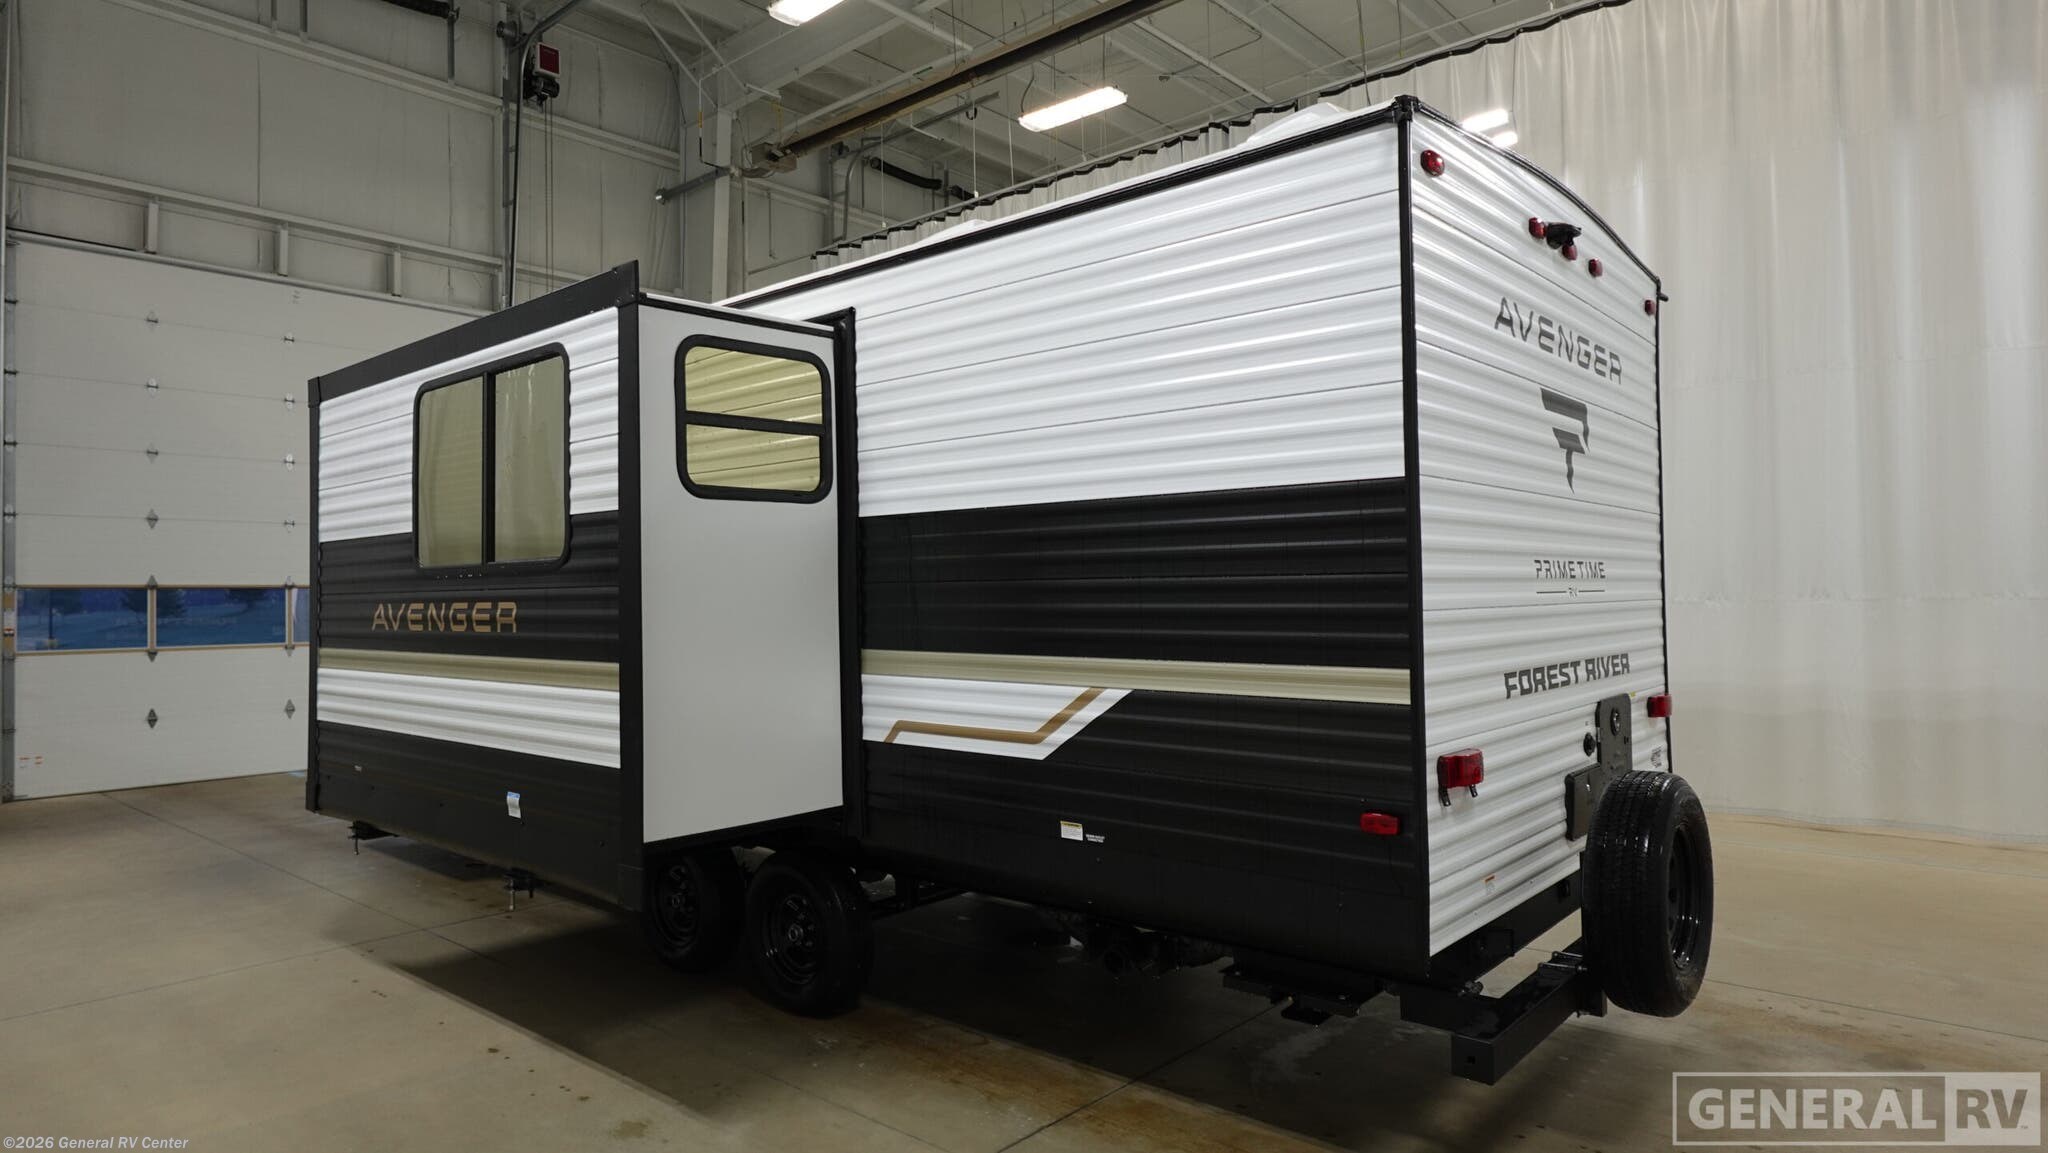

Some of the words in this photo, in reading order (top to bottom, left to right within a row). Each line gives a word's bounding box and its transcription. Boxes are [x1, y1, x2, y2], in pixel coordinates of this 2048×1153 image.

[1494, 296, 1622, 385] AVENGER
[371, 601, 517, 633] AVENGER
[1503, 660, 1581, 700] FOREST
[1584, 652, 1630, 682] RIVER
